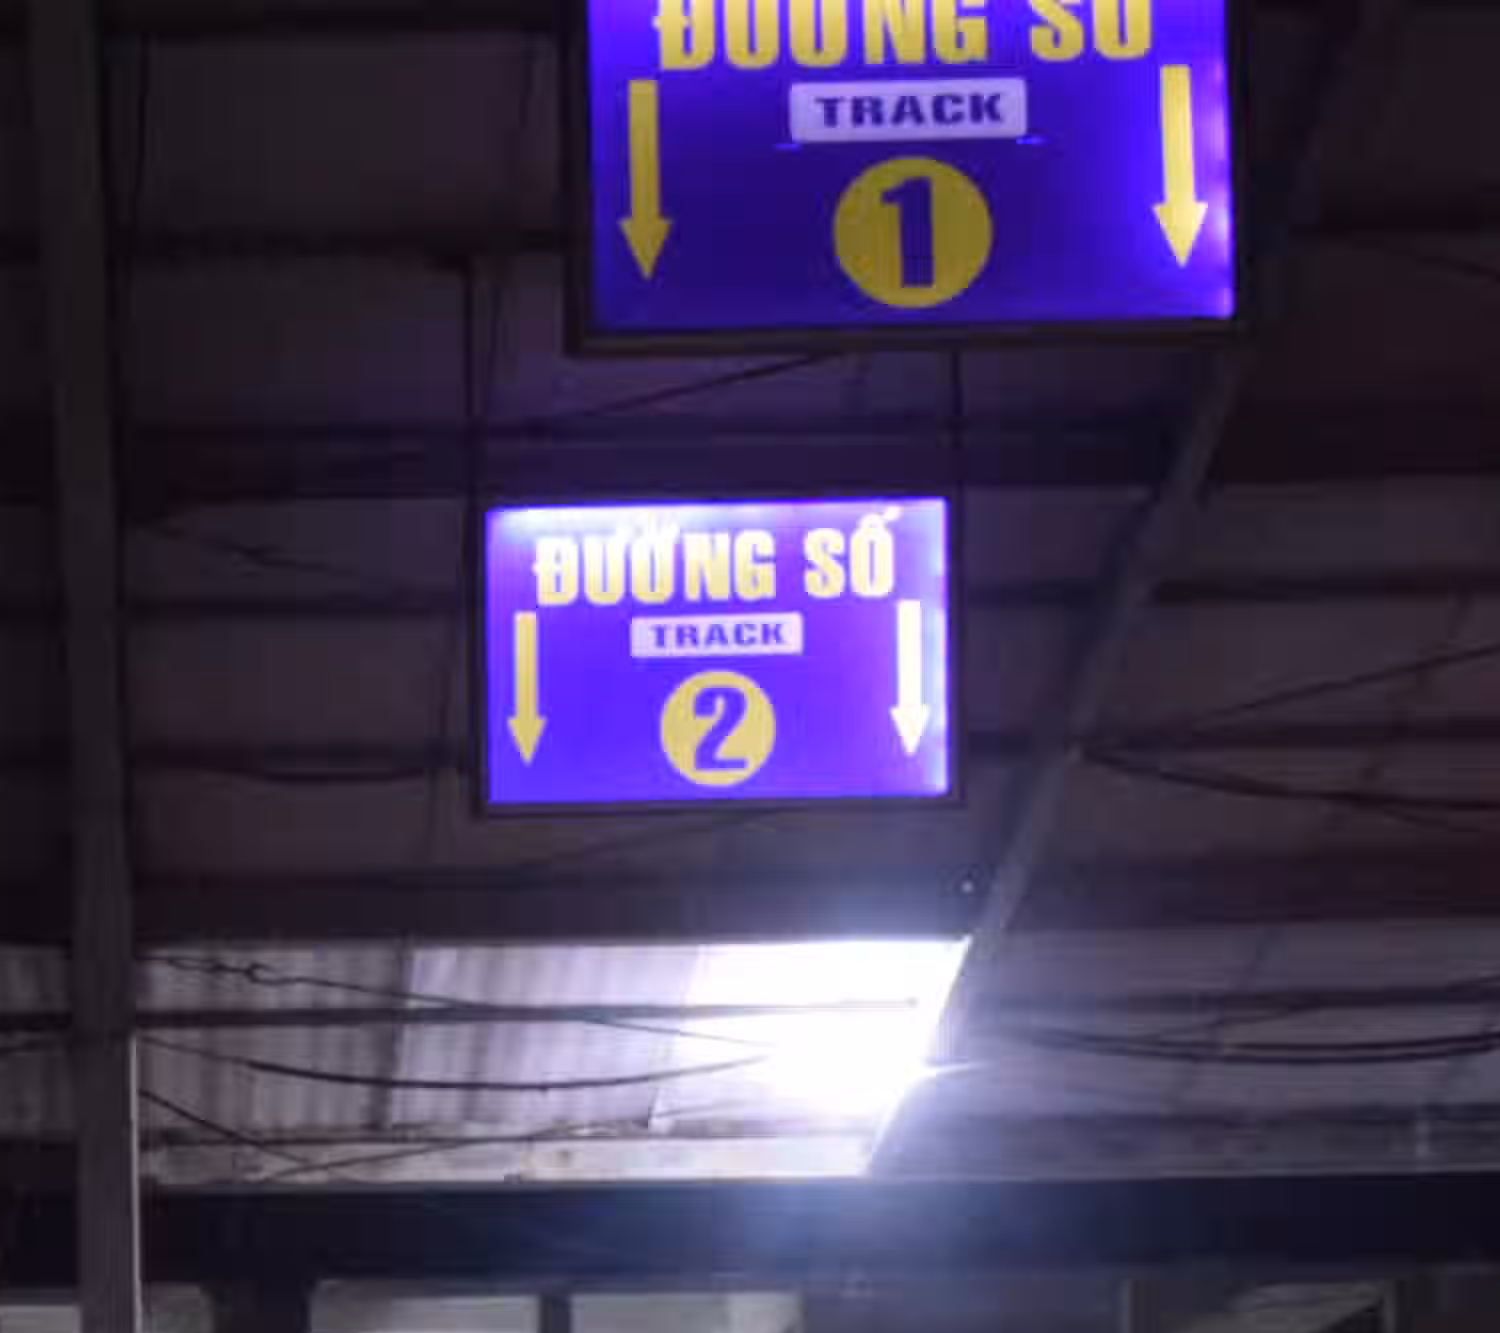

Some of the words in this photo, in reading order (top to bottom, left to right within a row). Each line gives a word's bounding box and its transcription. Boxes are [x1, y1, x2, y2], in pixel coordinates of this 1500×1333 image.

[815, 92, 1003, 128] TRACK
[881, 175, 934, 289] 1
[649, 620, 786, 650] TRACK
[692, 687, 750, 771] 2
